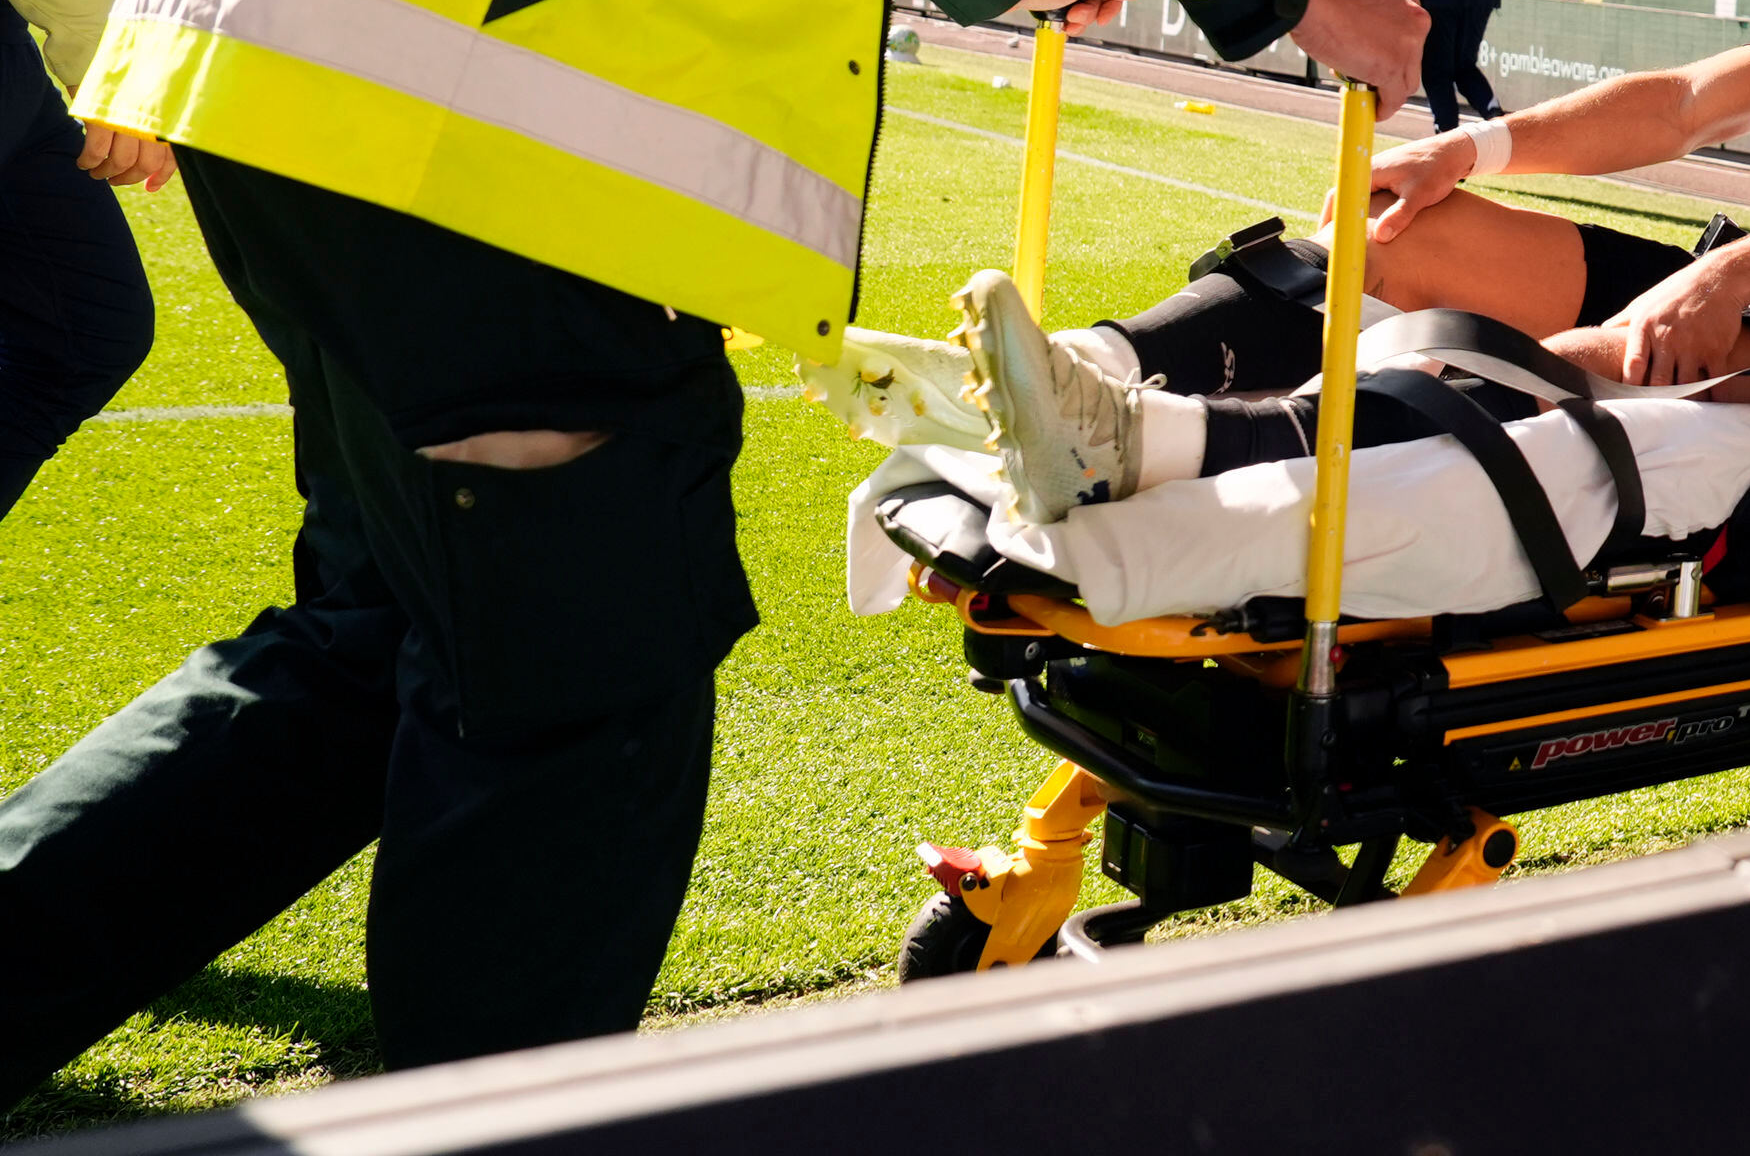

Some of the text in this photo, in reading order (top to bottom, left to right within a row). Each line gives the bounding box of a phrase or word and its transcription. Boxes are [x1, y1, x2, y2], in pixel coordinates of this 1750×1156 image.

[1478, 39, 1498, 68] 8+
[1530, 717, 1679, 770] power
[1675, 715, 1735, 745] pro
